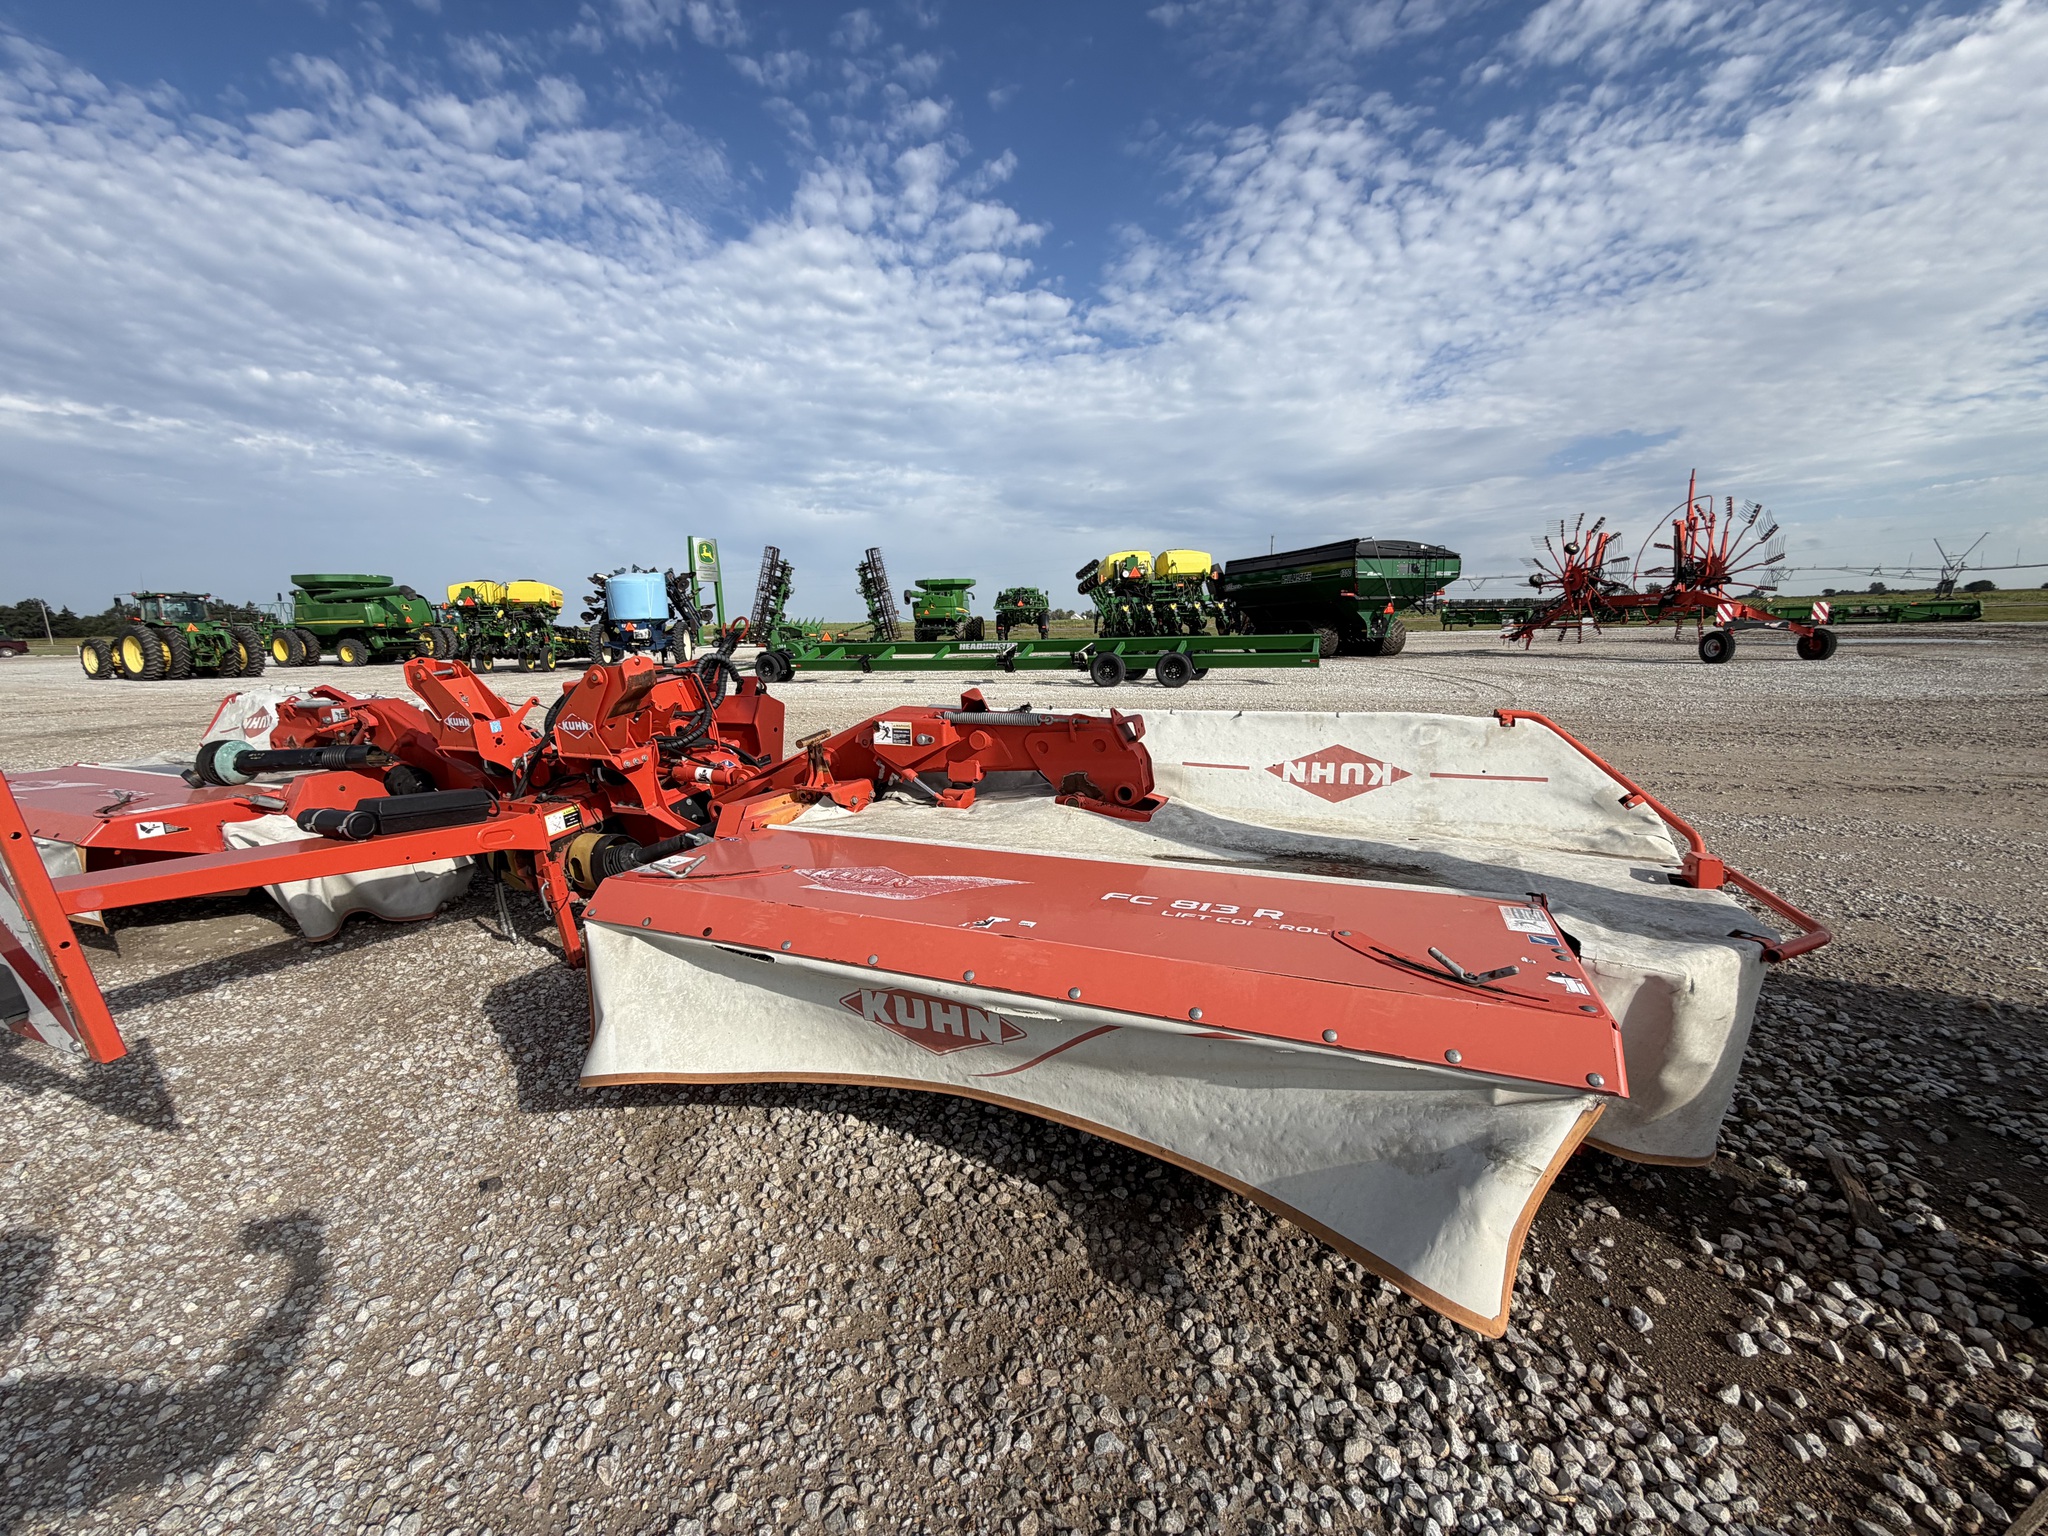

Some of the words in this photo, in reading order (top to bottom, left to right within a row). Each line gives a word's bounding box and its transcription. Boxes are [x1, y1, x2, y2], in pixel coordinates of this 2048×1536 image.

[446, 716, 471, 728] KUHN
[561, 721, 591, 732] KUHN
[1281, 759, 1393, 787] KUHN
[1100, 892, 1160, 906] FC
[1170, 899, 1240, 914] 813
[1252, 907, 1285, 921] R
[1161, 910, 1212, 921] LIFT
[1214, 916, 1331, 936] COROL
[859, 988, 1004, 1045] KUHN
